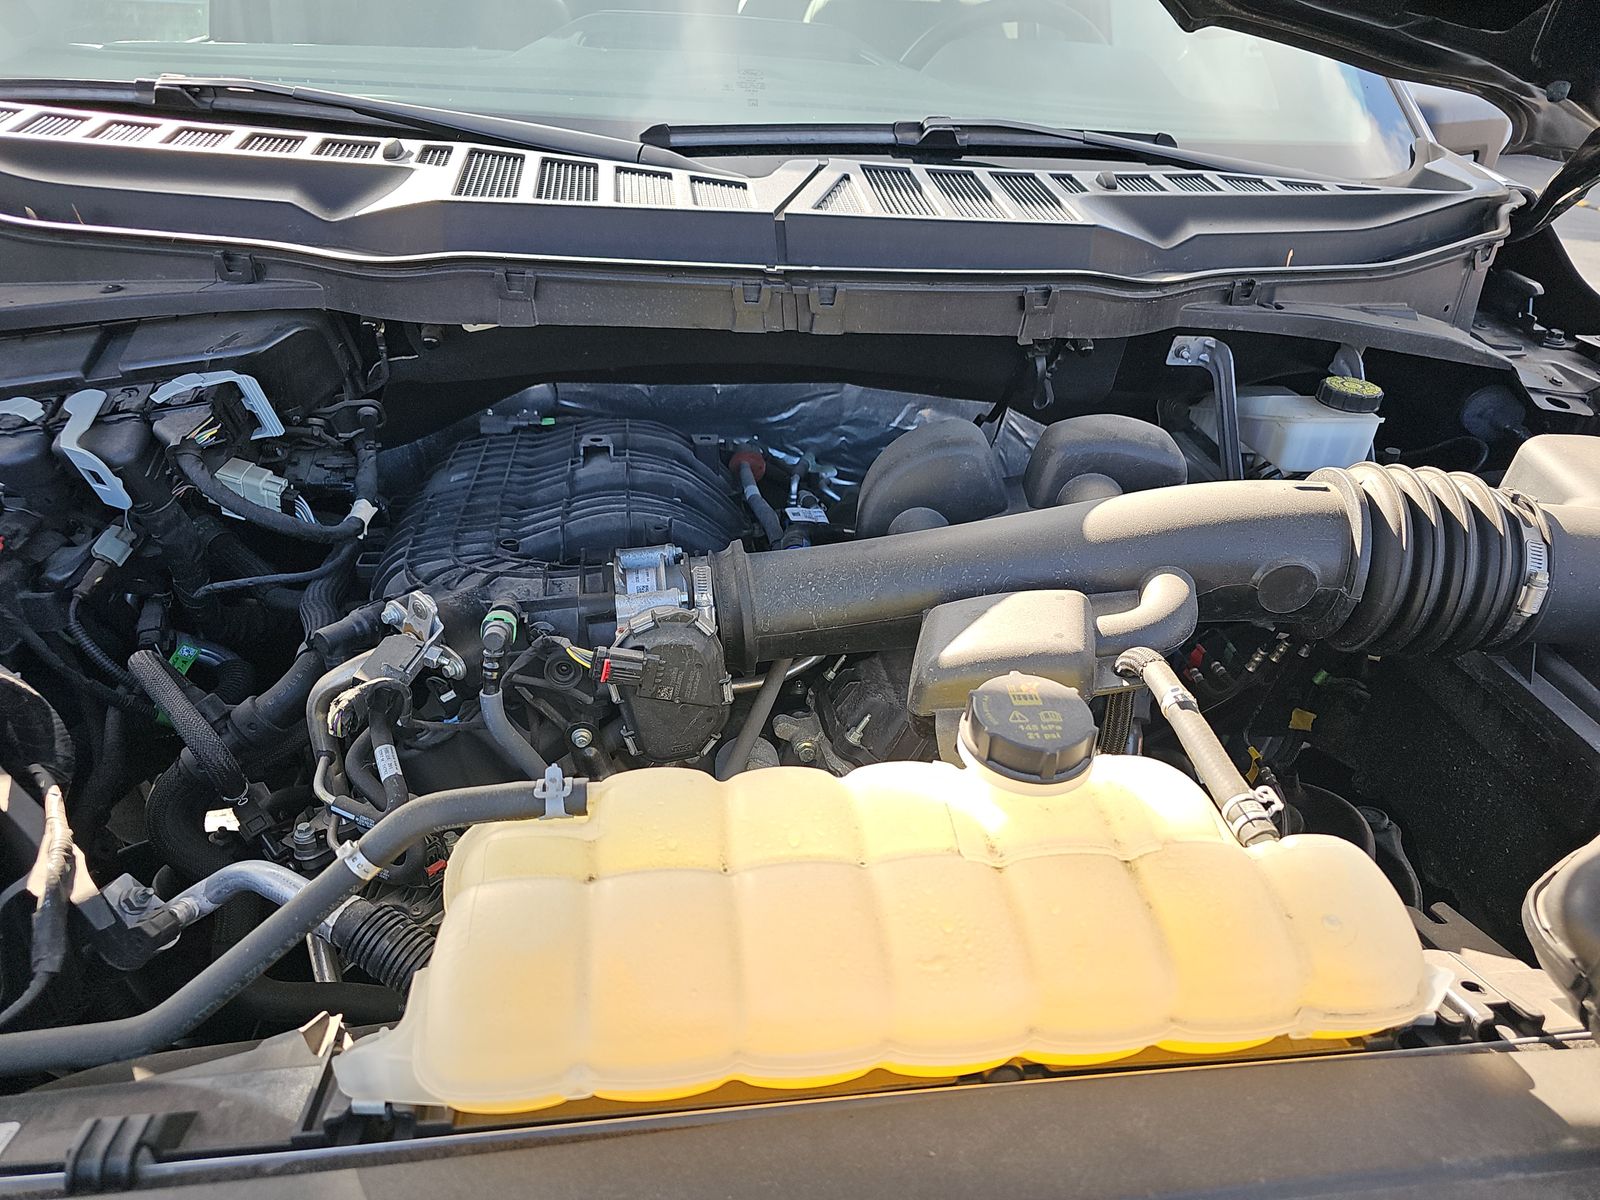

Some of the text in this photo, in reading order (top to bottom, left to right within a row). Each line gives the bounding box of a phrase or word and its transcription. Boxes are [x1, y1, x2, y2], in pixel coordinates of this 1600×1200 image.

[1040, 723, 1063, 731] kPa
[1026, 732, 1061, 740] 21 psi
